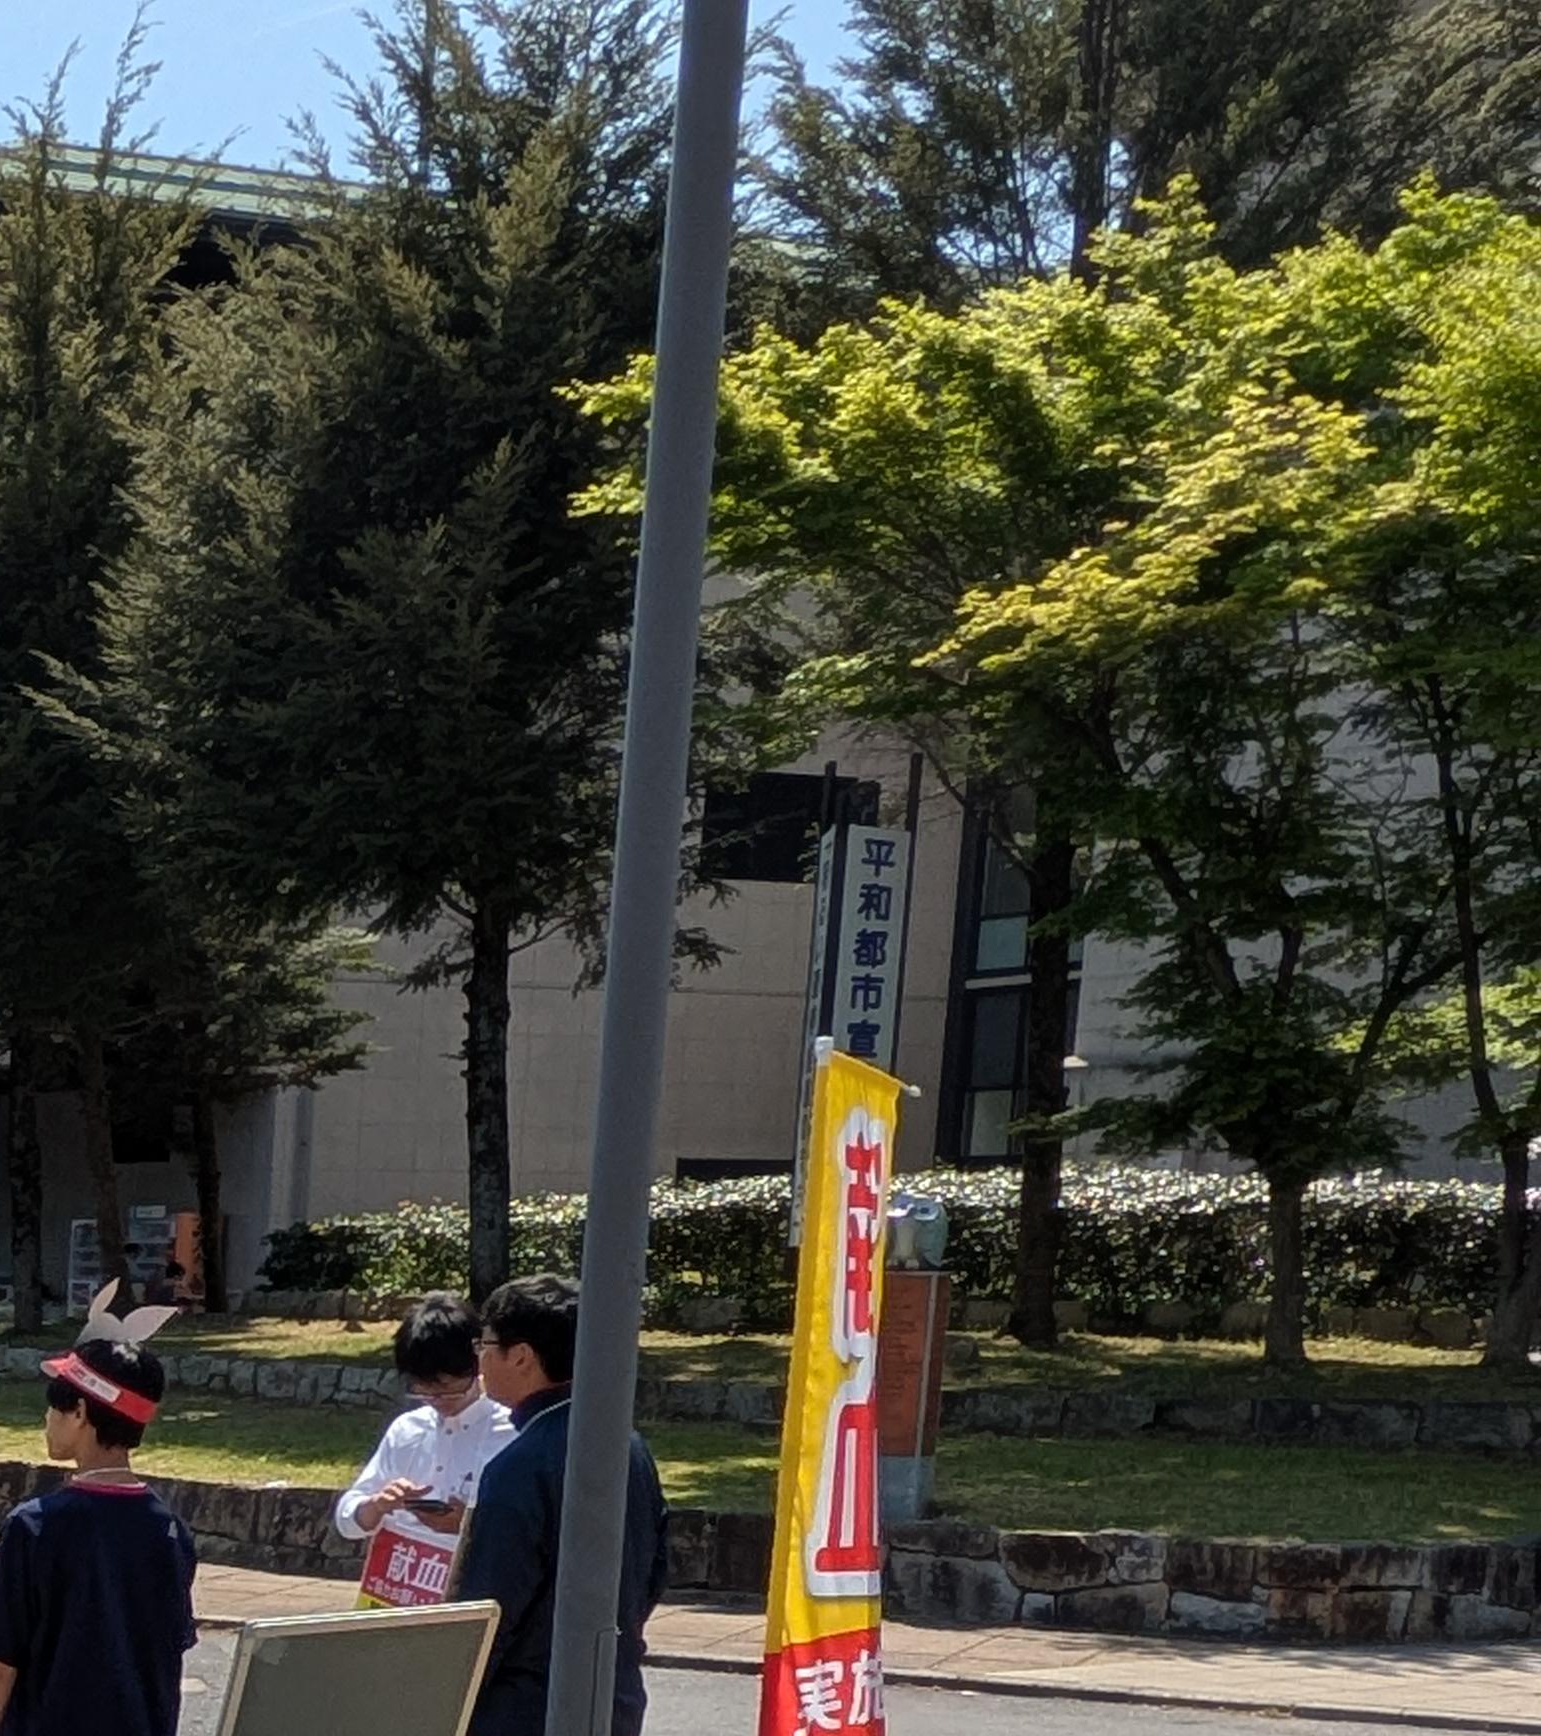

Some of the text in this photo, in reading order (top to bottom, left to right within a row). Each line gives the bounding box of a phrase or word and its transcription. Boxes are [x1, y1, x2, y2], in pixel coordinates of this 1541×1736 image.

[847, 837, 897, 1059] 平和都市宣
[385, 1541, 450, 1596] 献血
